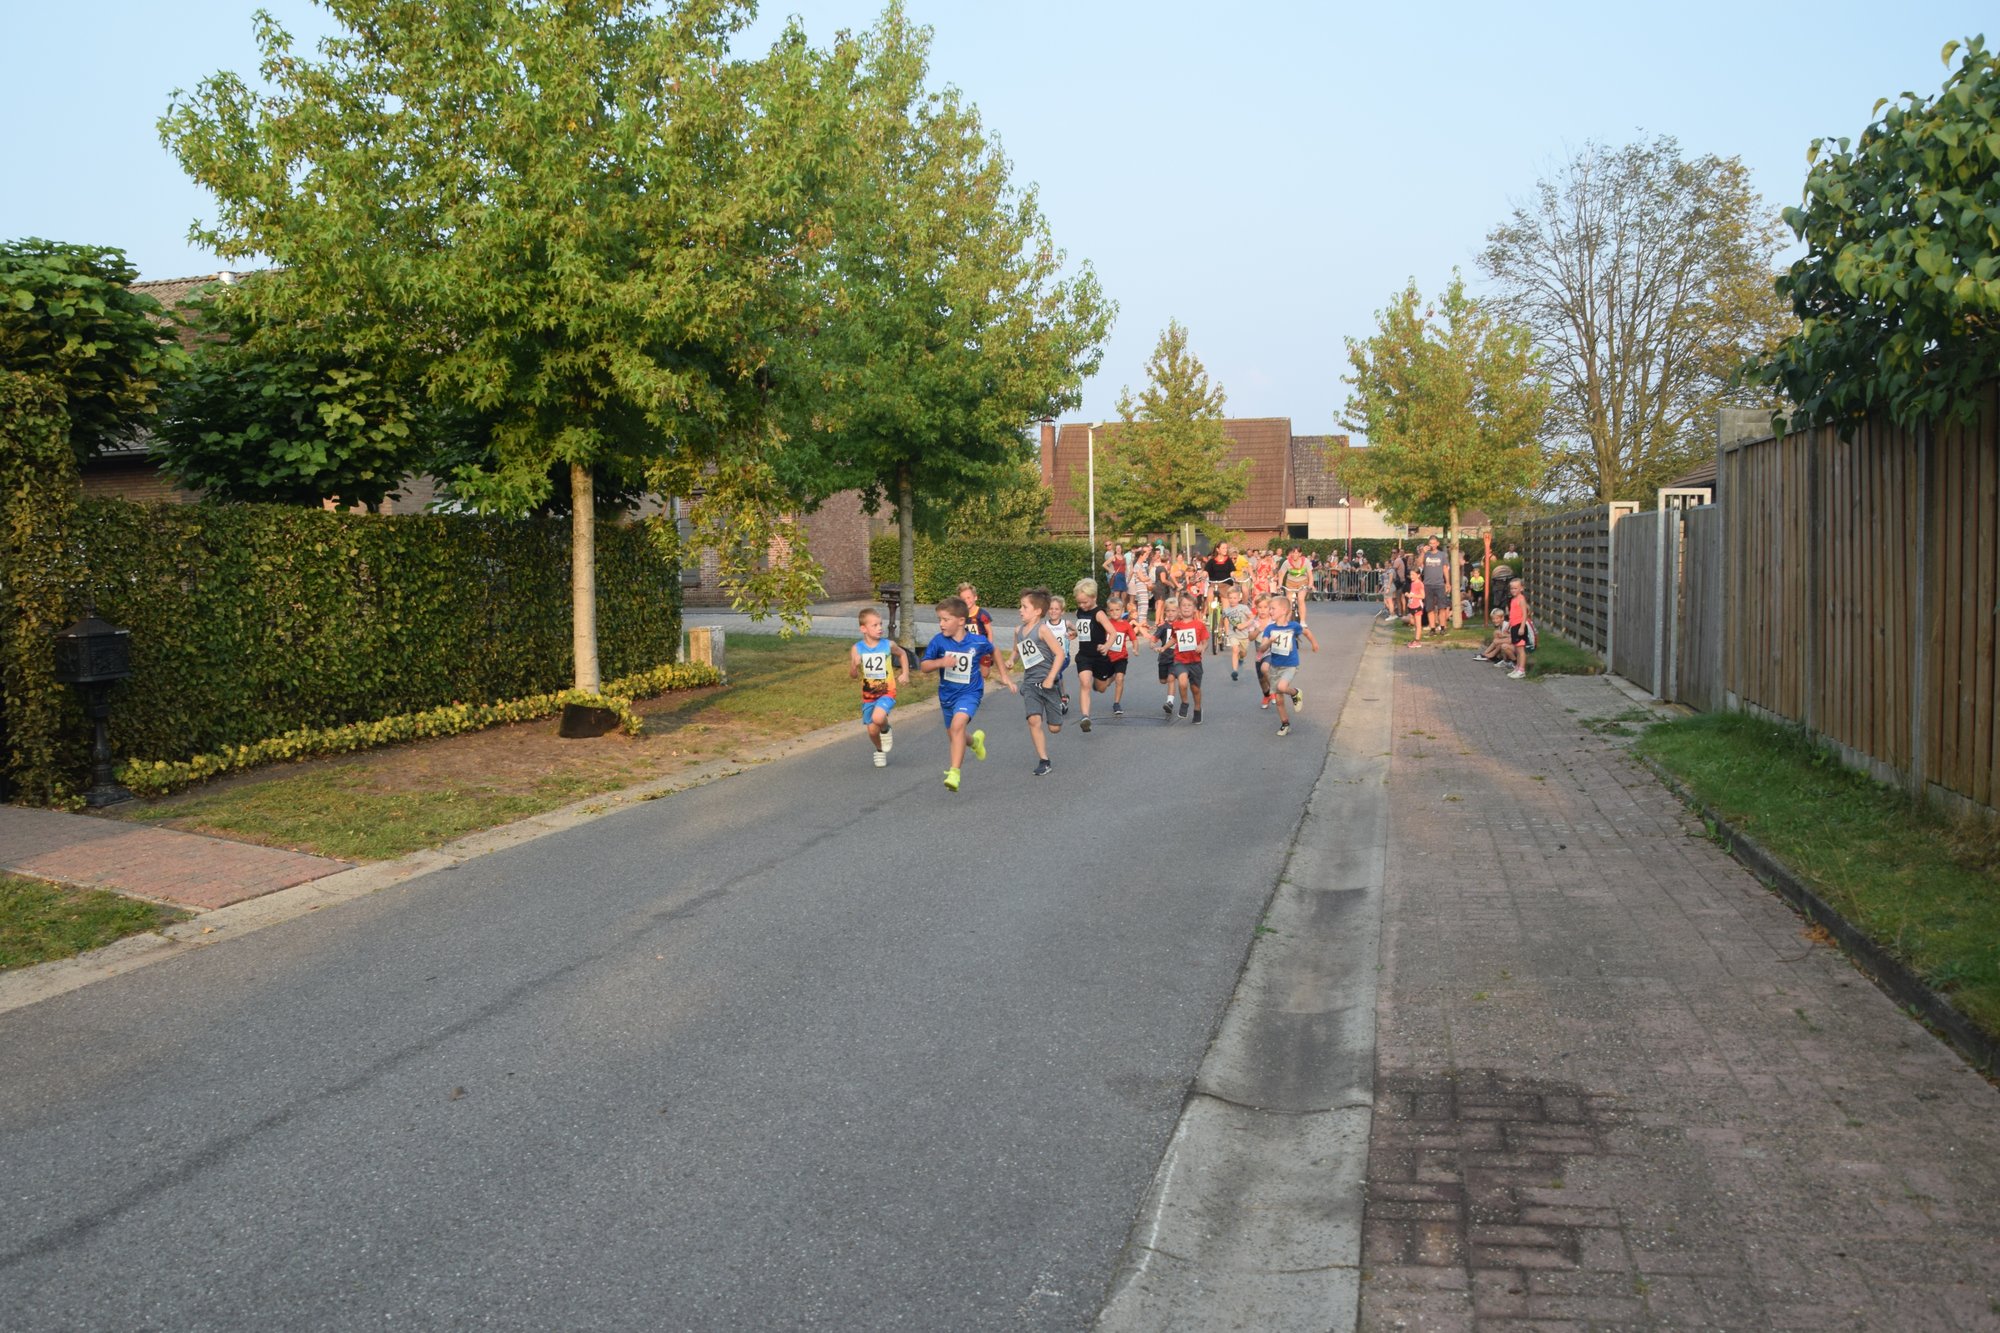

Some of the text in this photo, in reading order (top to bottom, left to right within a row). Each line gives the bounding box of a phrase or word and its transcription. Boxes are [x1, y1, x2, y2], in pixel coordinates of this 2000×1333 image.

[1078, 621, 1089, 634] 46
[1179, 631, 1194, 644] 45
[1022, 640, 1036, 656] 48
[865, 656, 883, 671] 42
